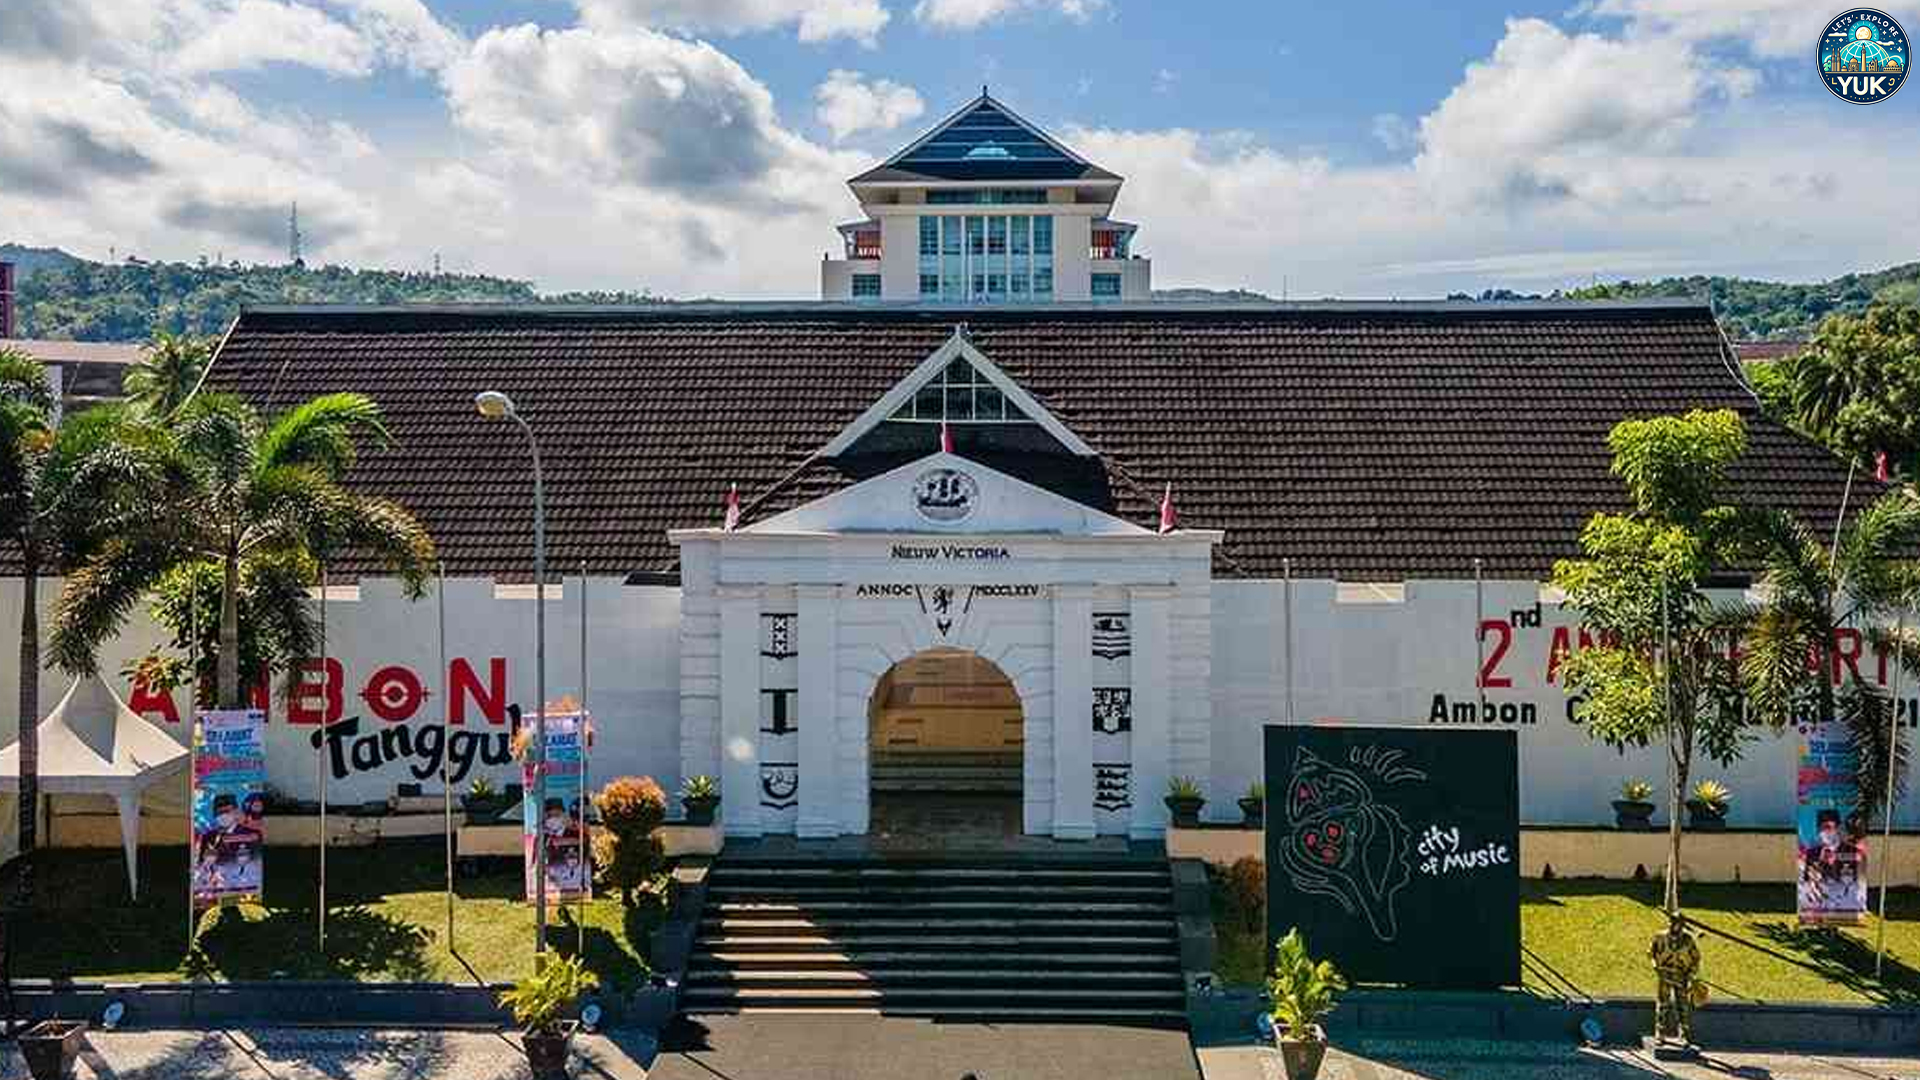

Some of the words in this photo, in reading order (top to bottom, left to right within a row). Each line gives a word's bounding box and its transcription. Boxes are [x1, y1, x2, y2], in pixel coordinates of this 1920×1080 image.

[127, 657, 506, 726] ABON
[1430, 694, 1537, 724] Ambon
[1417, 825, 1460, 856] city
[1419, 855, 1439, 875] of
